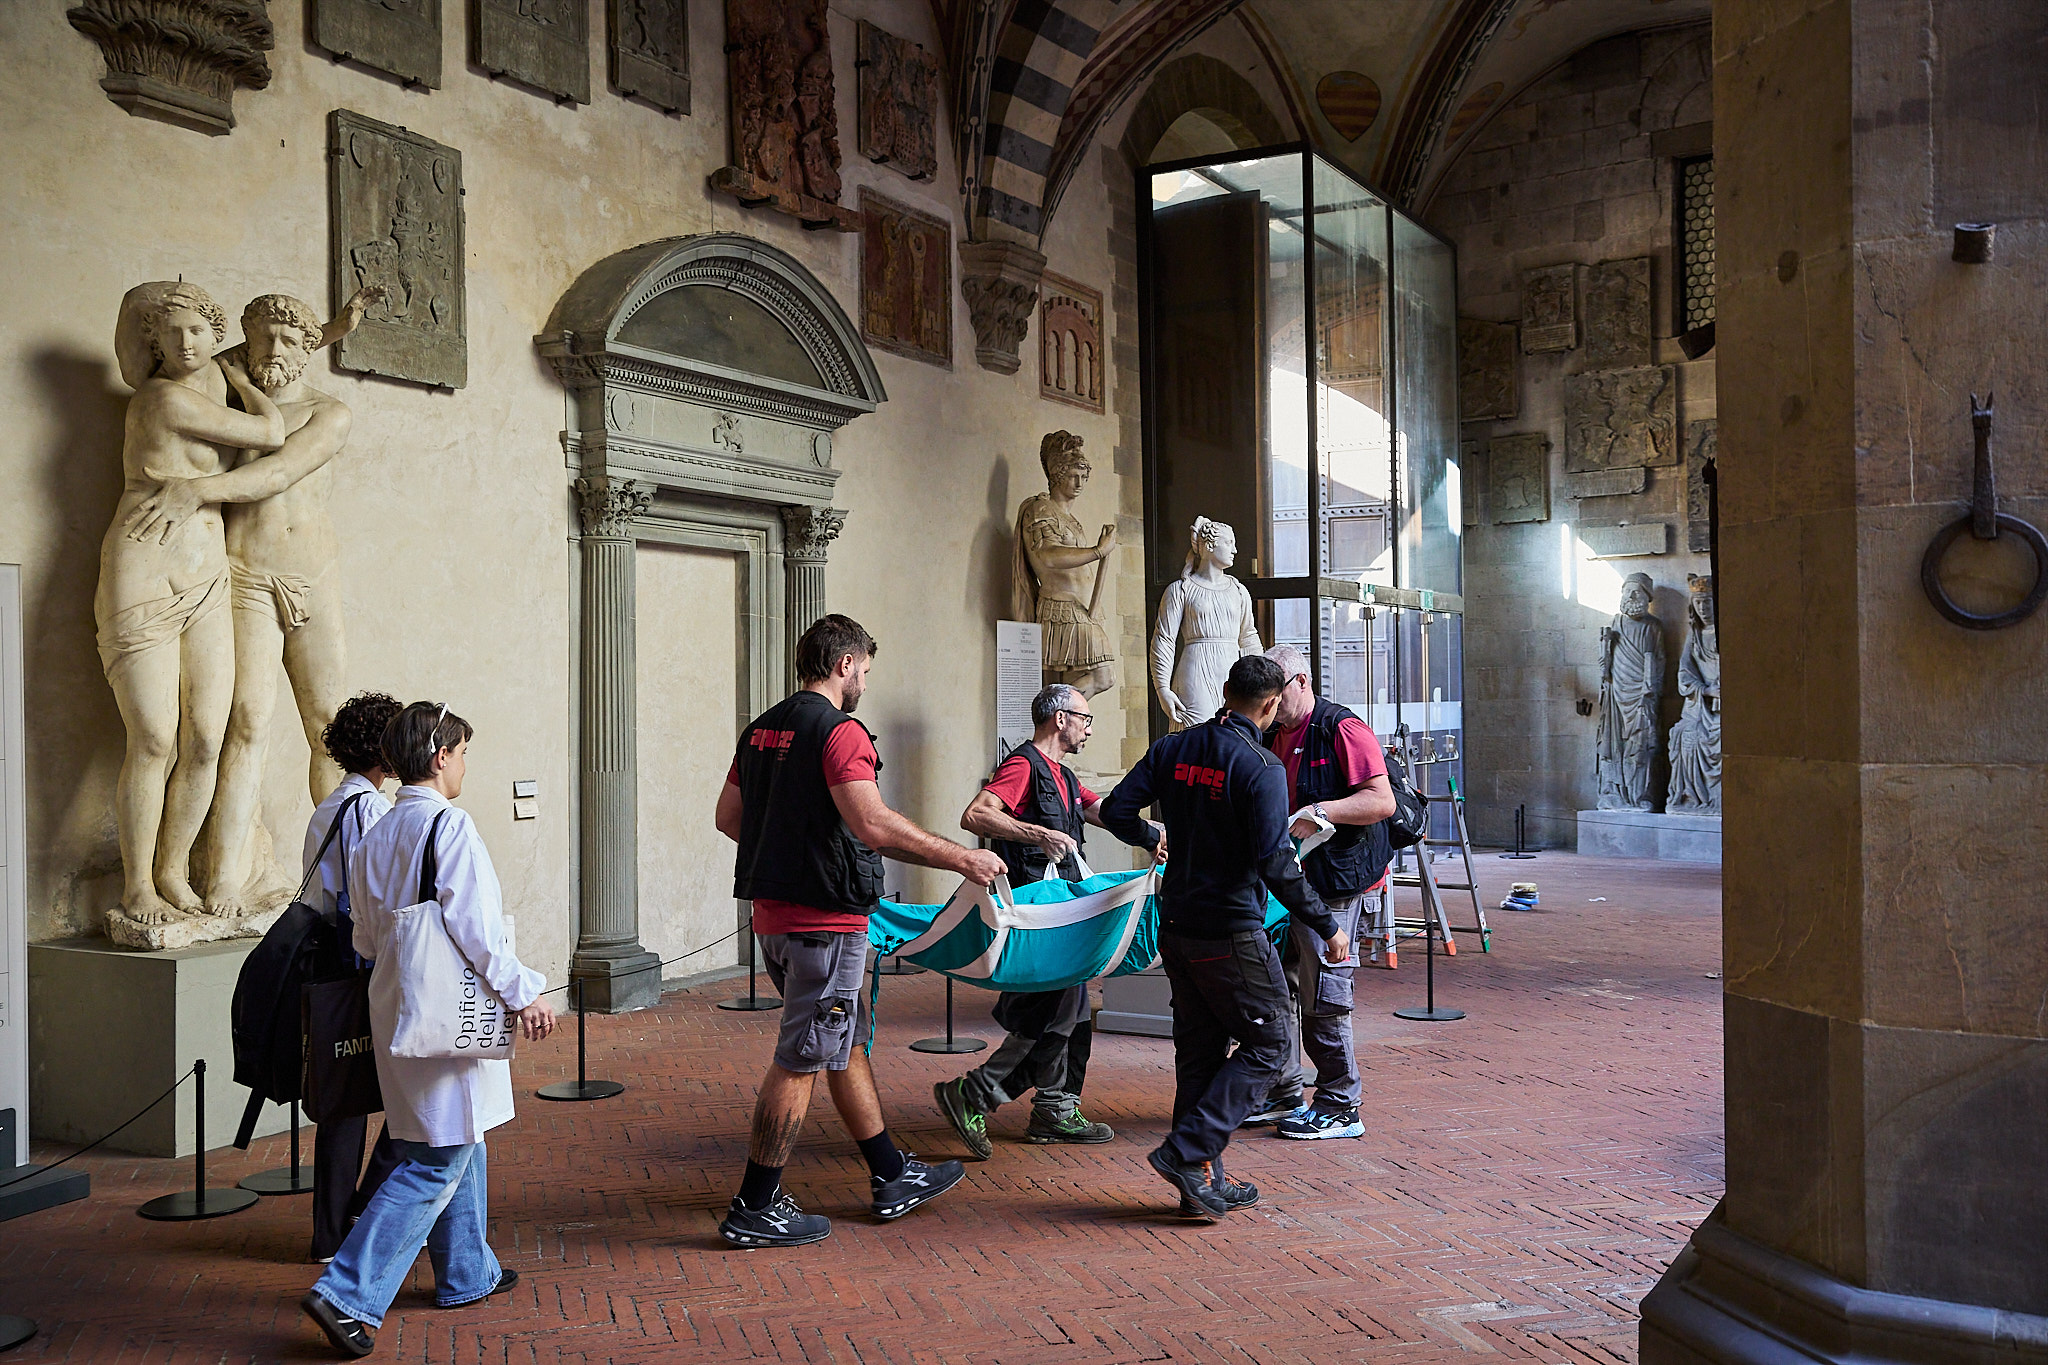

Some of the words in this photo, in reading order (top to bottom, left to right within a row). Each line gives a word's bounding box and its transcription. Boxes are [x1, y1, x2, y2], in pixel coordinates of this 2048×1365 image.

[454, 966, 477, 1050] Opificio
[476, 997, 498, 1049] delle
[496, 1003, 516, 1048] Piet
